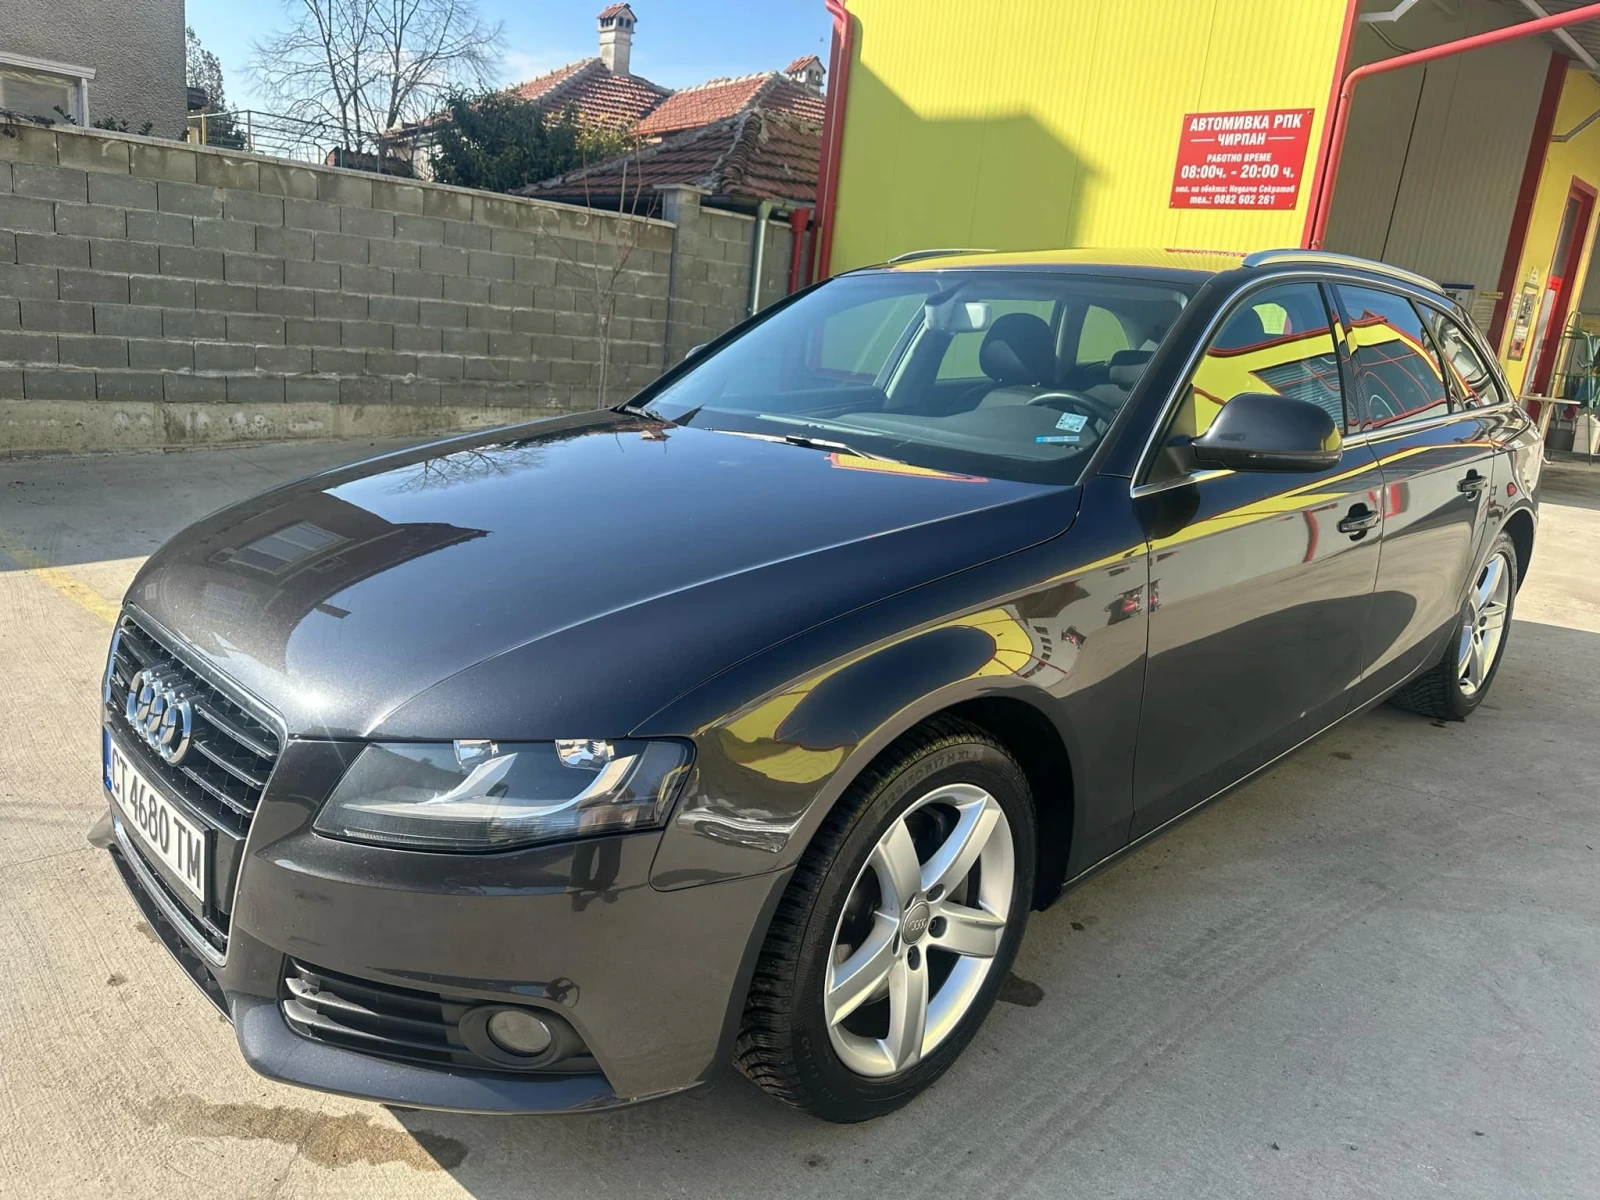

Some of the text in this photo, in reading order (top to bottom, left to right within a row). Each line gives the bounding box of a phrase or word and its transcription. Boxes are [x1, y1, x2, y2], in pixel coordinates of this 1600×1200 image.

[1189, 113, 1303, 131] АВТОМИВКА РПК
[1217, 132, 1267, 146] ЧИРПАН
[1206, 152, 1272, 163] РАБОТНО ВРЕМЕ
[1181, 165, 1227, 179] 08:00ч.
[1240, 164, 1279, 178] 20:00
[1282, 167, 1295, 178] ч.
[1214, 194, 1236, 204] 0882
[1238, 194, 1256, 204] 602
[1257, 194, 1276, 204] 261
[112, 748, 201, 890] CT 4680 TM
